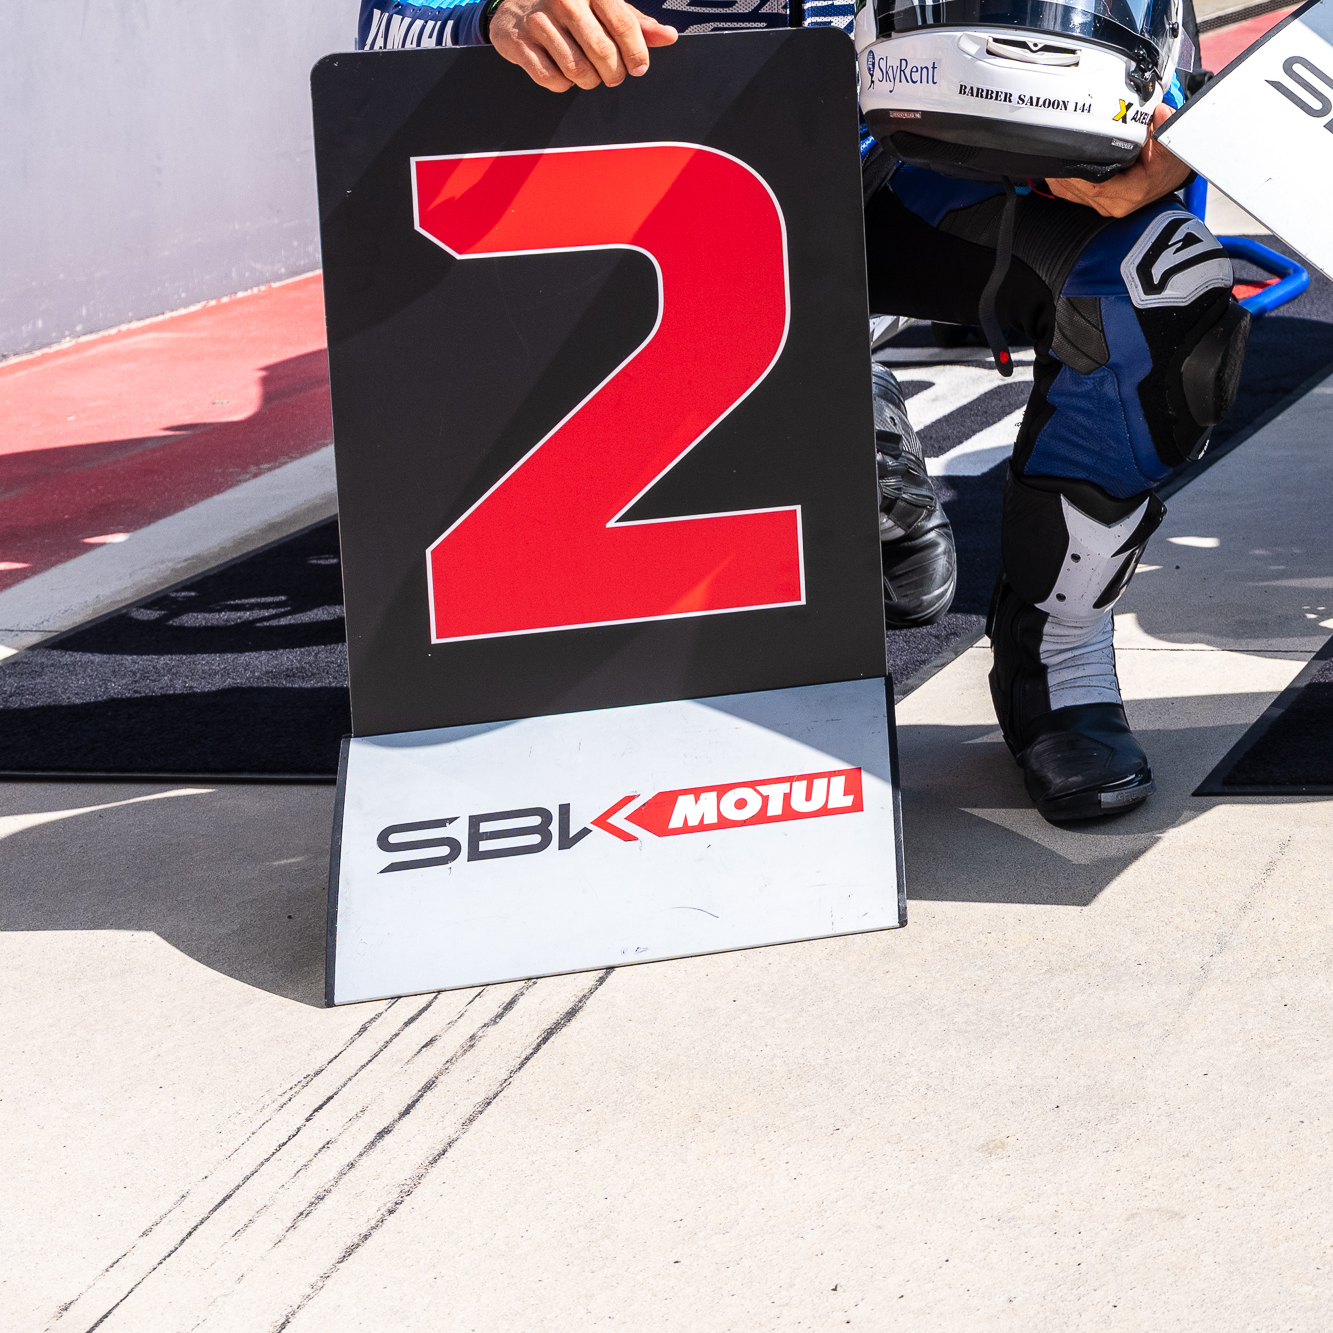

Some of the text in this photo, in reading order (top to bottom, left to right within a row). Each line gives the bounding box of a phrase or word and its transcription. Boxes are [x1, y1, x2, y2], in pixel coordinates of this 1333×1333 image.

[877, 55, 938, 93] SkyRent
[958, 83, 1092, 114] BARBER SALOON 144
[411, 141, 806, 644] 2
[667, 773, 856, 831] MOTUL
